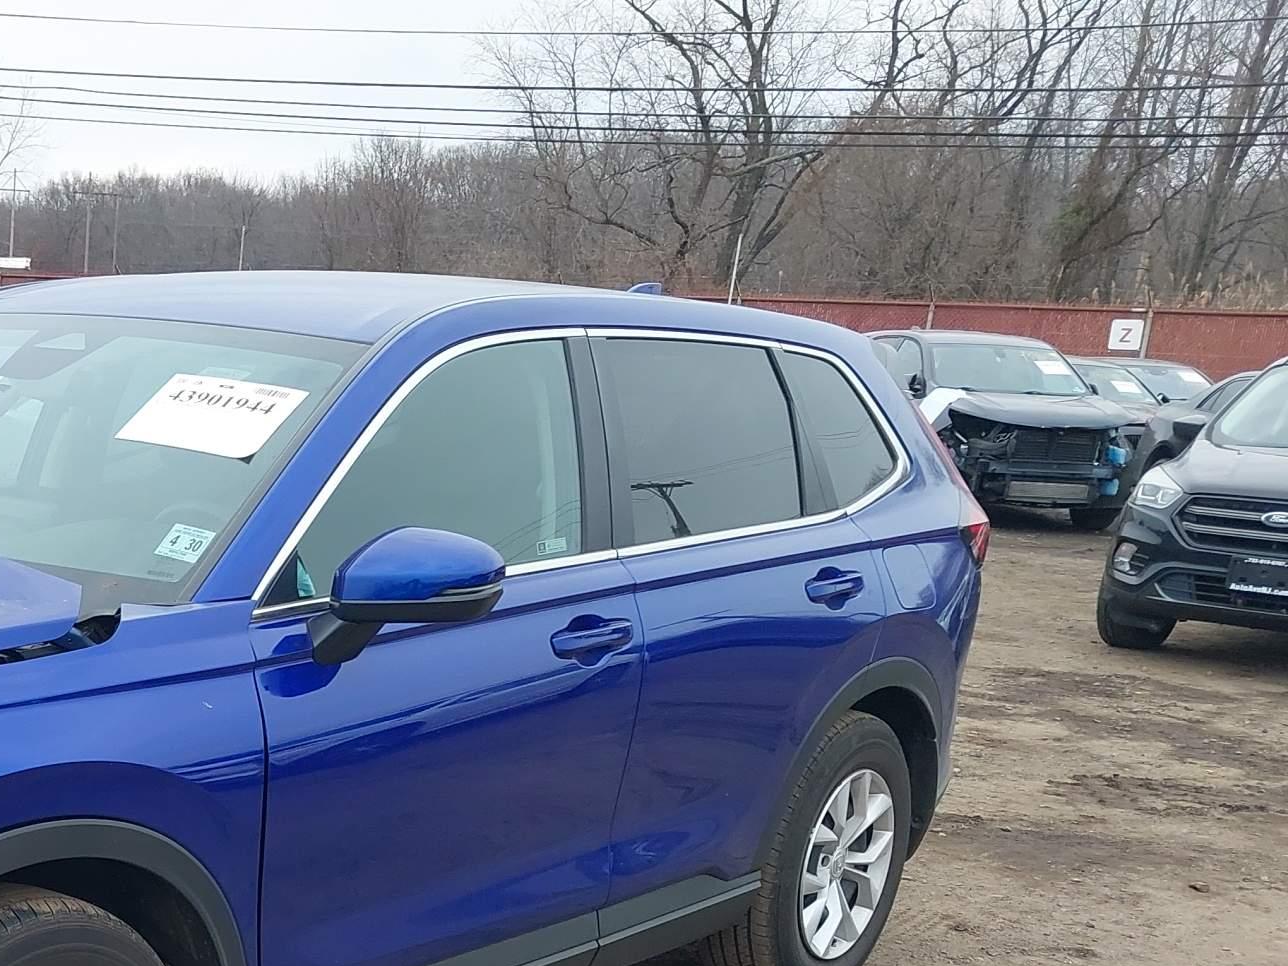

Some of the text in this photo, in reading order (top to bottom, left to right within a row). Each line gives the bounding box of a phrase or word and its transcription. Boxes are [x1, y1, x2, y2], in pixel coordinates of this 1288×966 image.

[1119, 328, 1133, 343] Z
[169, 389, 277, 415] 43901944
[169, 534, 181, 547] 4
[184, 538, 203, 553] 30
